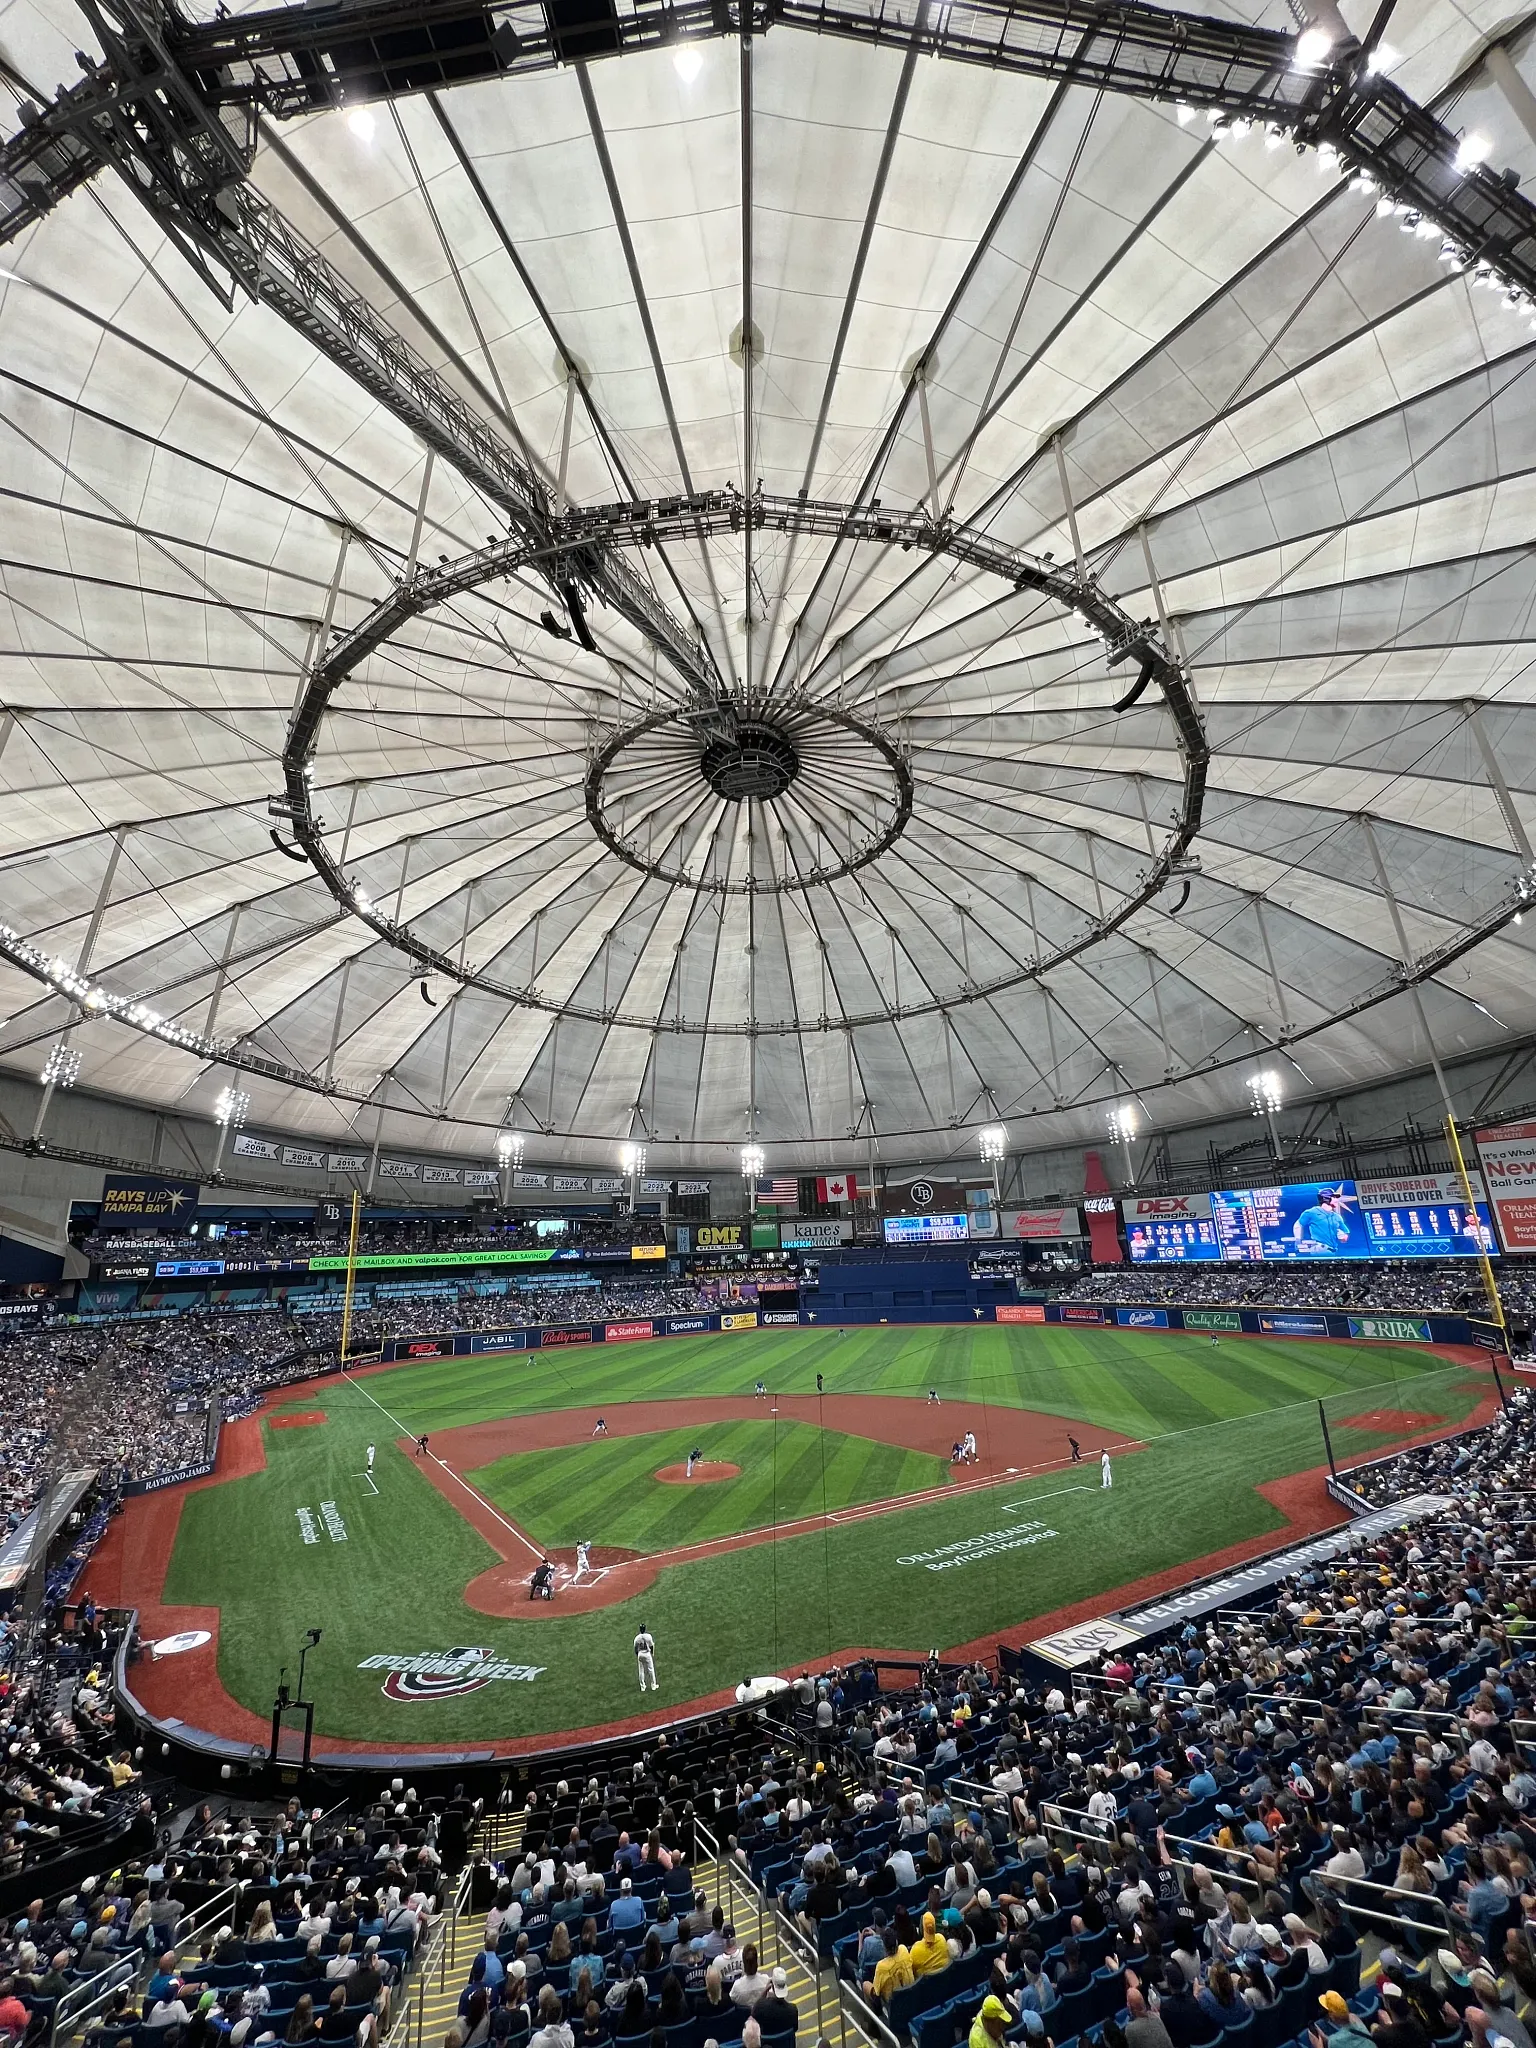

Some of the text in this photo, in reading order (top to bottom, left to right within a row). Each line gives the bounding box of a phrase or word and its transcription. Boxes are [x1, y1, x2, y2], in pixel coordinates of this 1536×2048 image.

[1488, 1126, 1524, 1135] ORLANDO
[1494, 1131, 1521, 1139] HEALTH
[238, 1148, 271, 1157] CHAMPIONS
[244, 1143, 266, 1152] 2008
[292, 1153, 313, 1161] 2008
[1483, 1152, 1497, 1160] It's
[1508, 1149, 1536, 1157] Whol
[1361, 1178, 1438, 1194] DRIVE SOBER OR
[1490, 1179, 1511, 1188] Ball
[106, 1190, 167, 1203] RAYS UP
[915, 1186, 930, 1200] TB
[1361, 1193, 1378, 1205] GET
[1380, 1191, 1415, 1204] PULLED
[1417, 1190, 1443, 1201] OVER
[104, 1203, 167, 1213] TAMPA BAY
[1137, 1197, 1190, 1214] DEX
[1255, 1197, 1280, 1207] LOWE
[324, 1204, 340, 1220] TB
[1149, 1211, 1197, 1220] imaging
[698, 1226, 741, 1245] GMF
[794, 1224, 840, 1238] kane's
[313, 1260, 339, 1268] CHECK
[363, 1258, 395, 1266] MAILBOX
[415, 1256, 457, 1264] valpak.com
[96, 1293, 119, 1303] VIVA
[670, 1321, 704, 1331] Spectrum
[1186, 1313, 1238, 1329] Quality Roofing
[1380, 1320, 1420, 1338] RIPA
[482, 1335, 515, 1344] JABIL
[542, 1331, 591, 1345] Bally SPORTS
[408, 1342, 440, 1354] DEX
[415, 1350, 442, 1358] imaging
[145, 1464, 211, 1490] RAYMOND JAMES
[896, 1520, 1047, 1565] ORLANDO HEALTH
[924, 1529, 1060, 1571] Bayfront Hospital
[1122, 1579, 1242, 1626] WELCOME
[1240, 1566, 1268, 1581] TO
[1357, 1511, 1408, 1531] FIELD
[1041, 1625, 1118, 1658] RAYS
[419, 1651, 441, 1659] 20
[357, 1654, 548, 1681] OPENING WEEK
[1160, 1880, 1181, 1899] 24
